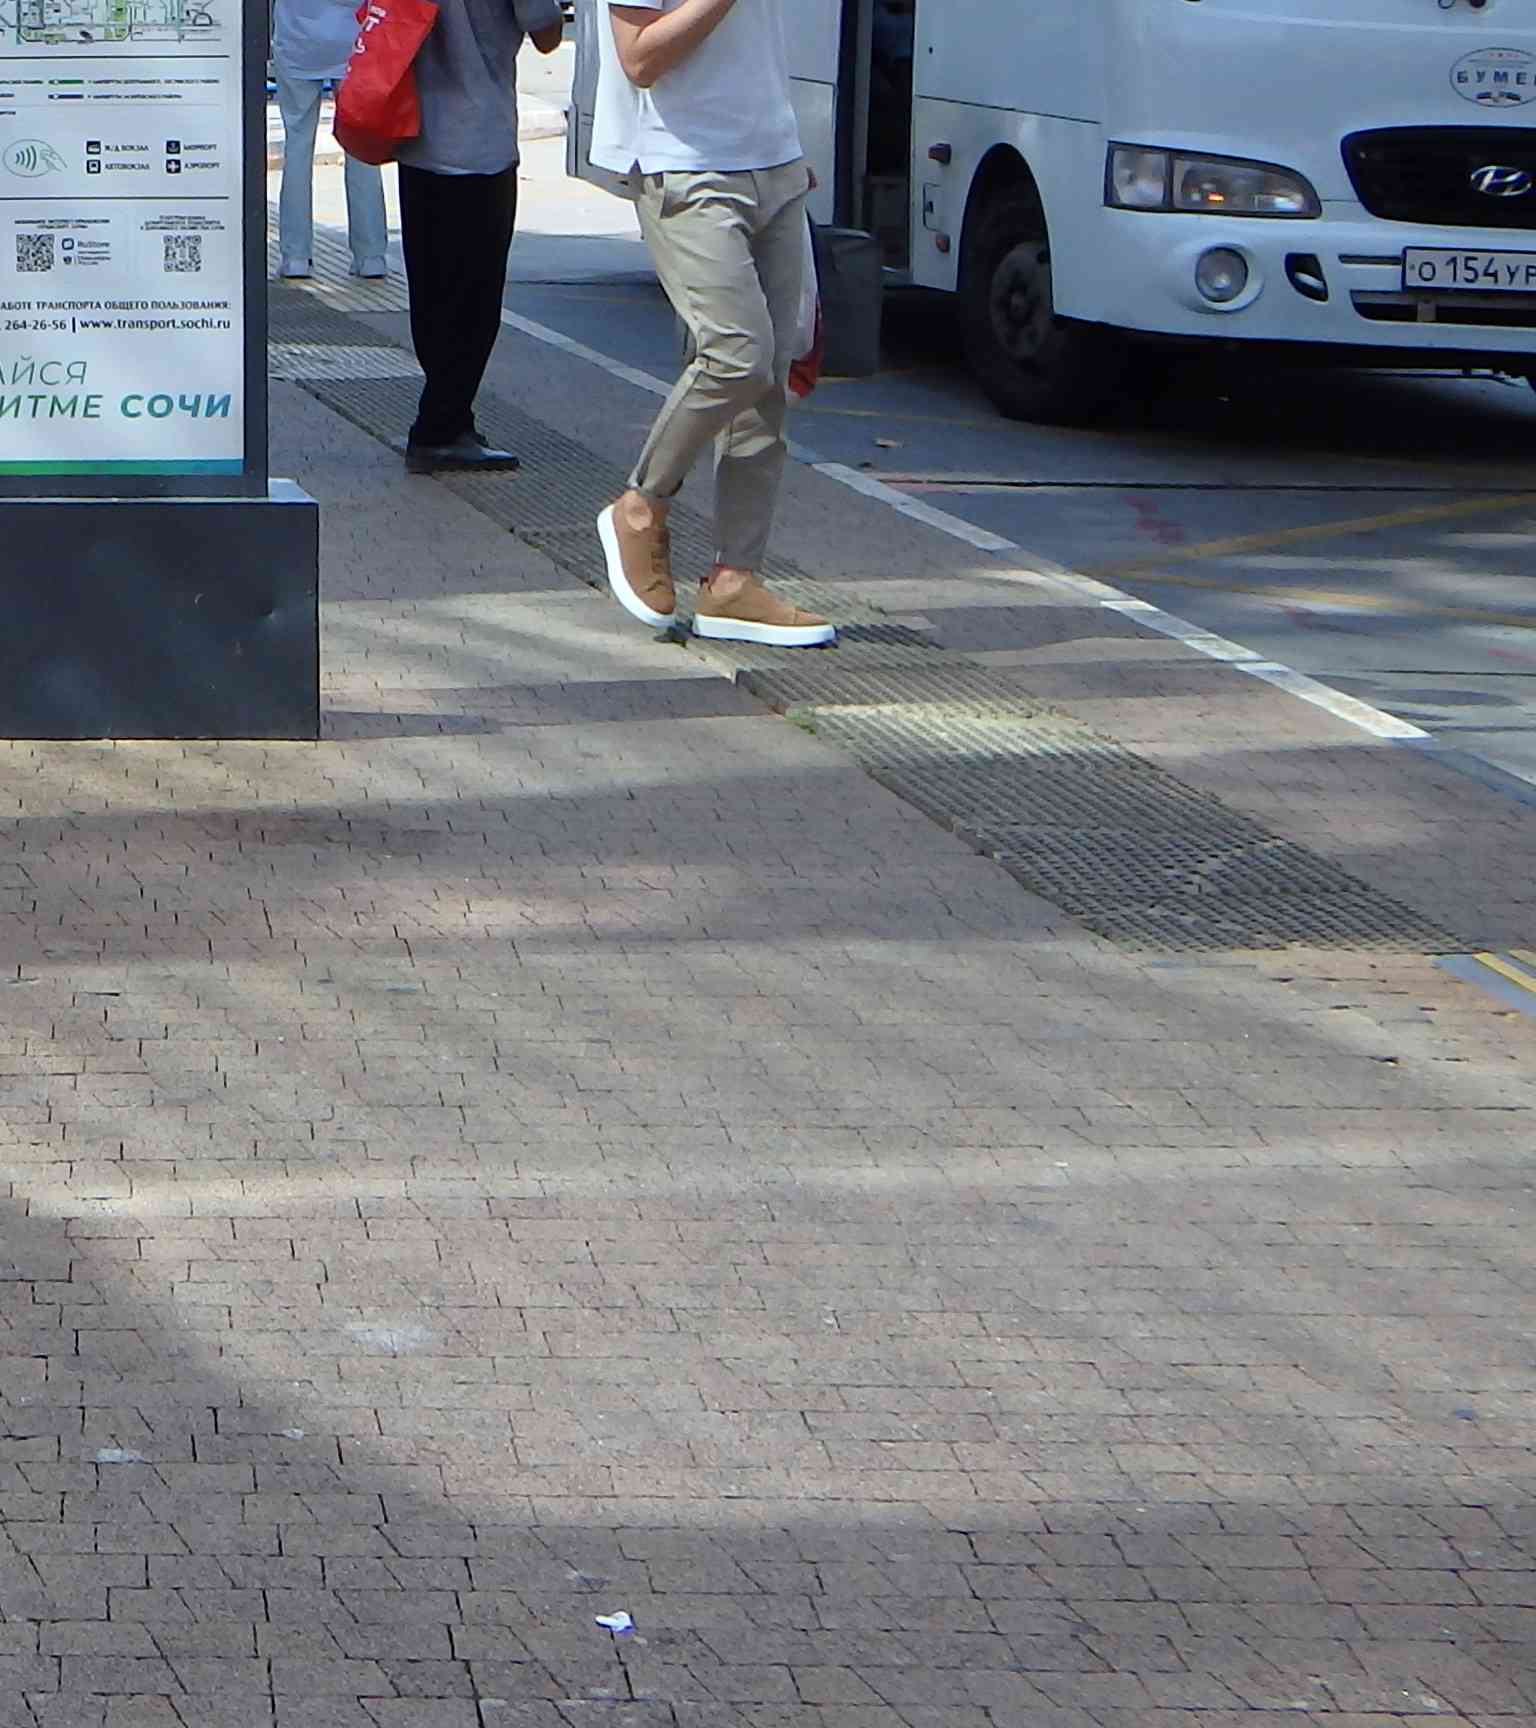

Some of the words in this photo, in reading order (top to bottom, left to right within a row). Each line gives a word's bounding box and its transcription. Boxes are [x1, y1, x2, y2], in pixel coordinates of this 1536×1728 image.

[4, 318, 68, 331] 264-26-56
[79, 317, 231, 331] www.transport.sochi.ru
[120, 393, 232, 419] СОЧИ
